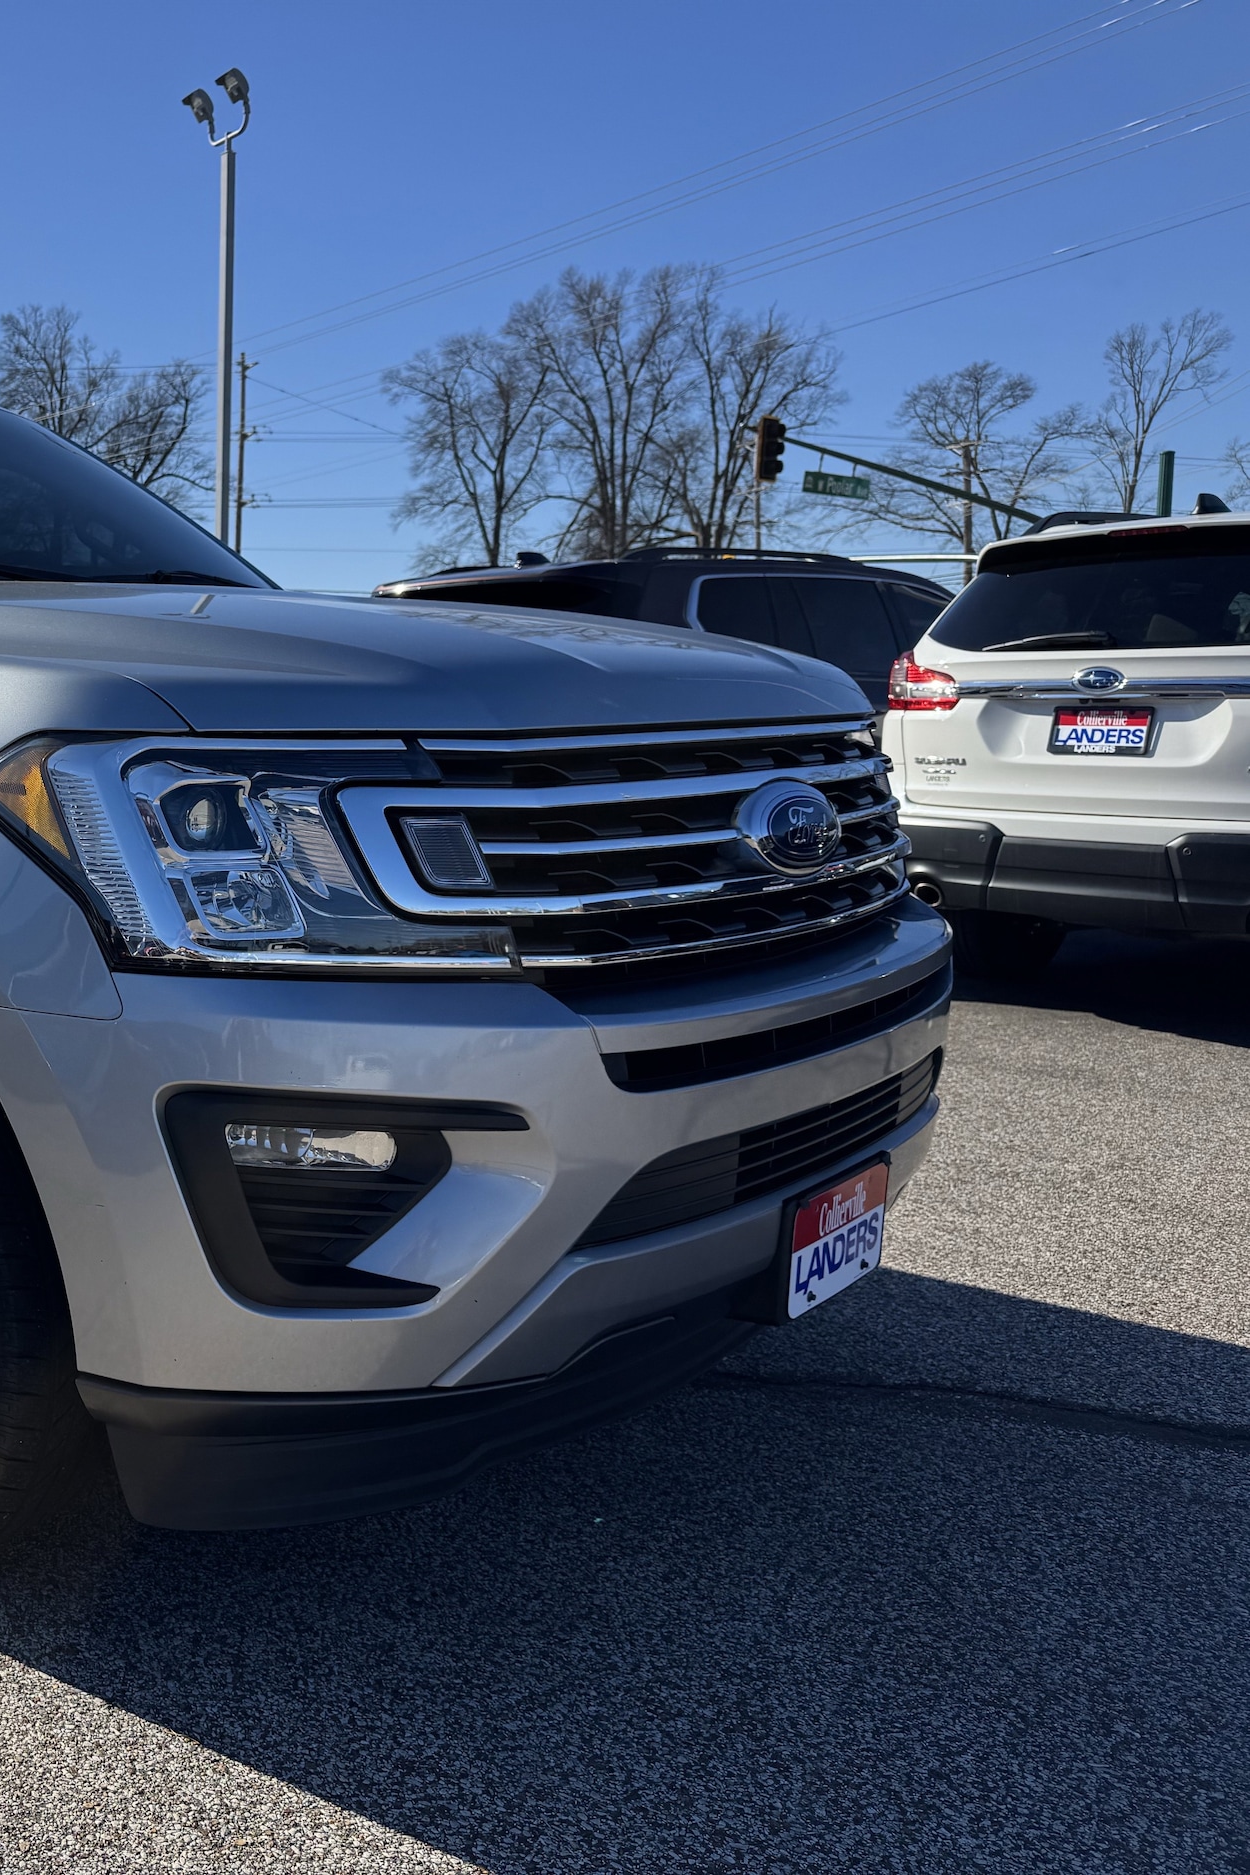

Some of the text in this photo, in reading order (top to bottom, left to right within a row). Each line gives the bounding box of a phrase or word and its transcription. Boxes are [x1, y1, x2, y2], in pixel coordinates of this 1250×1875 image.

[1077, 711, 1128, 726] Collierville
[1054, 728, 1144, 745] LANDERS
[1074, 745, 1116, 753] LANDERS
[788, 805, 829, 847] Ford
[819, 1181, 867, 1237] Collierville
[795, 1212, 879, 1296] LANDERS
